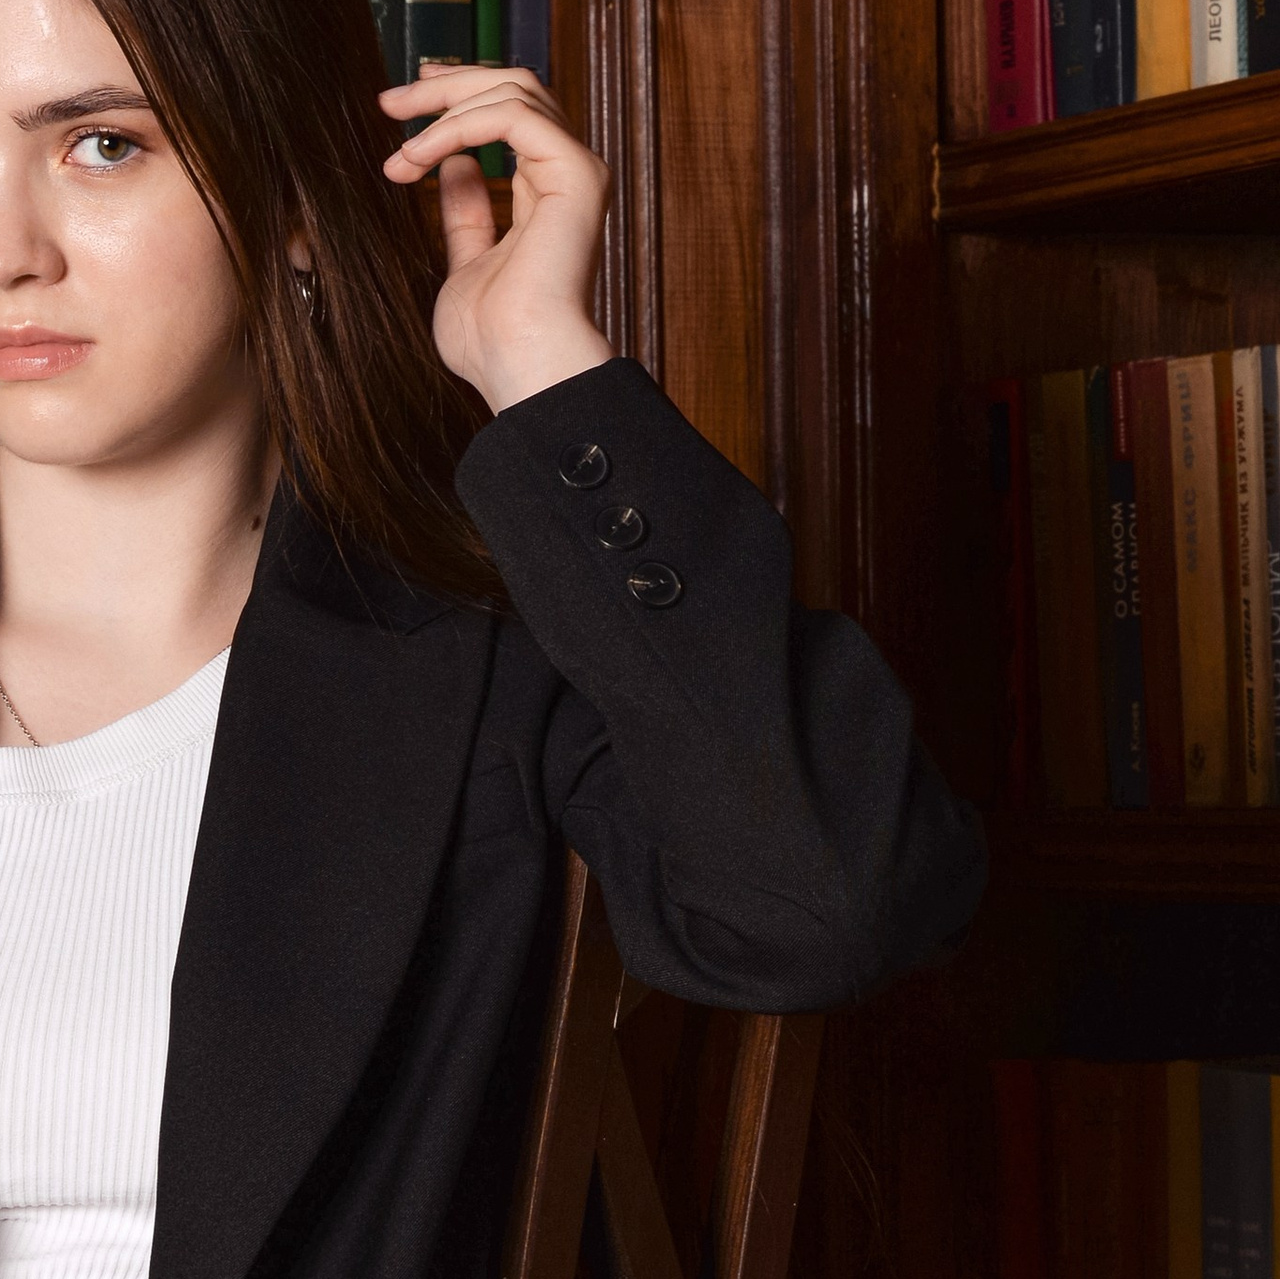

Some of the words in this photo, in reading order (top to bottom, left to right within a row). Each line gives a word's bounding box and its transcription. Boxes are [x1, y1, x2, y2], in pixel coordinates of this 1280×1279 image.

[1234, 386, 1248, 466] УРЖУМА
[1238, 470, 1250, 494] ИЗ
[1111, 502, 1127, 593] САМОМ
[1239, 500, 1252, 588] МАЛЬЧИК
[1114, 599, 1128, 618] О
[1242, 596, 1256, 681] ГОЛУБЕВА
[1243, 686, 1258, 776] АНТОНИНА
